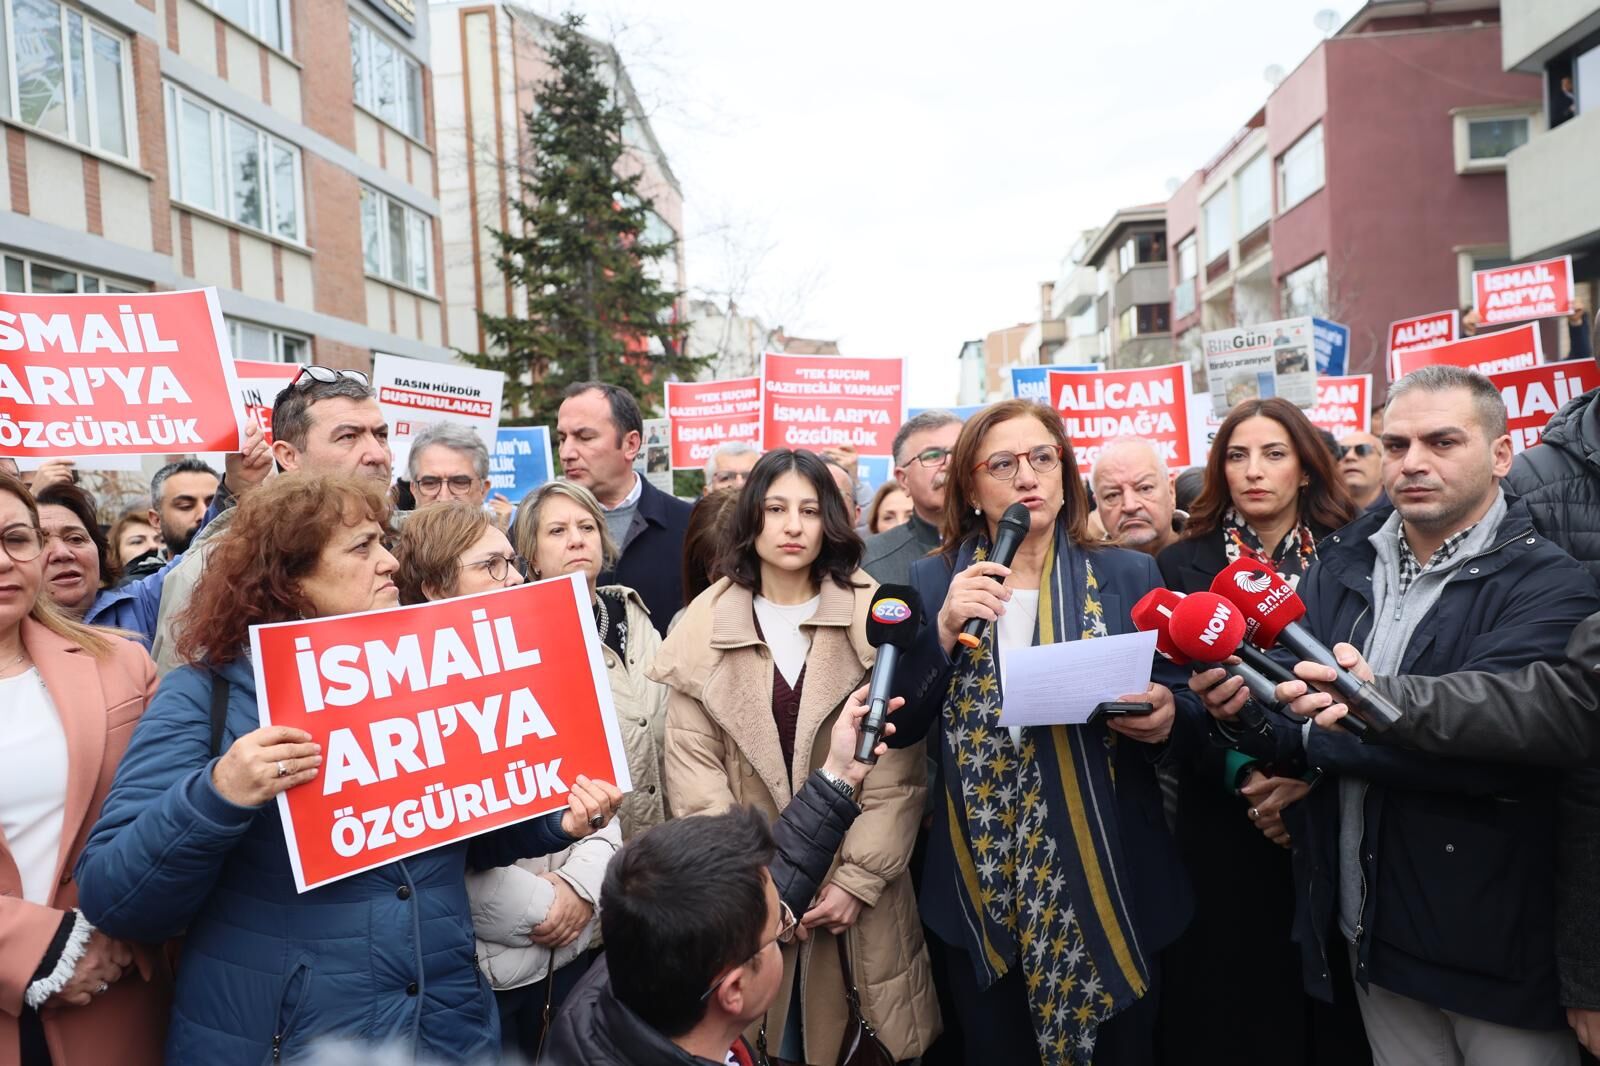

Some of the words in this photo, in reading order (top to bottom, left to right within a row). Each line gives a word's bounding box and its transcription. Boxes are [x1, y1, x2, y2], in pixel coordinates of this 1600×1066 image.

[1484, 265, 1555, 292] İSMAİL
[1486, 285, 1556, 308] ARI'YA
[0, 304, 179, 353] SMAİL
[1394, 319, 1449, 346] ALİCAN
[0, 364, 192, 405] ARI'YA
[394, 377, 431, 390] BASIN
[432, 382, 481, 397] HÜRDÜR
[766, 380, 842, 394] GAZETECİLİK
[827, 369, 870, 381] SUÇUM
[381, 389, 491, 416] SUSTURULAMAZ
[1058, 378, 1175, 411] ALİCAN
[773, 403, 831, 423] İSMAİL
[833, 407, 891, 425] ARI'YA
[0, 414, 203, 448] ÖZGÜRLÜK
[678, 423, 727, 442] İSMAİL
[785, 426, 877, 446] ÖZGÜRLÜK
[876, 604, 905, 618] SZC
[1257, 585, 1291, 612] anka
[1199, 602, 1231, 646] NOW
[295, 608, 541, 713] İSMAİL
[323, 687, 557, 796] ARI'YA
[331, 758, 570, 857] ÖZGÜRLÜK
